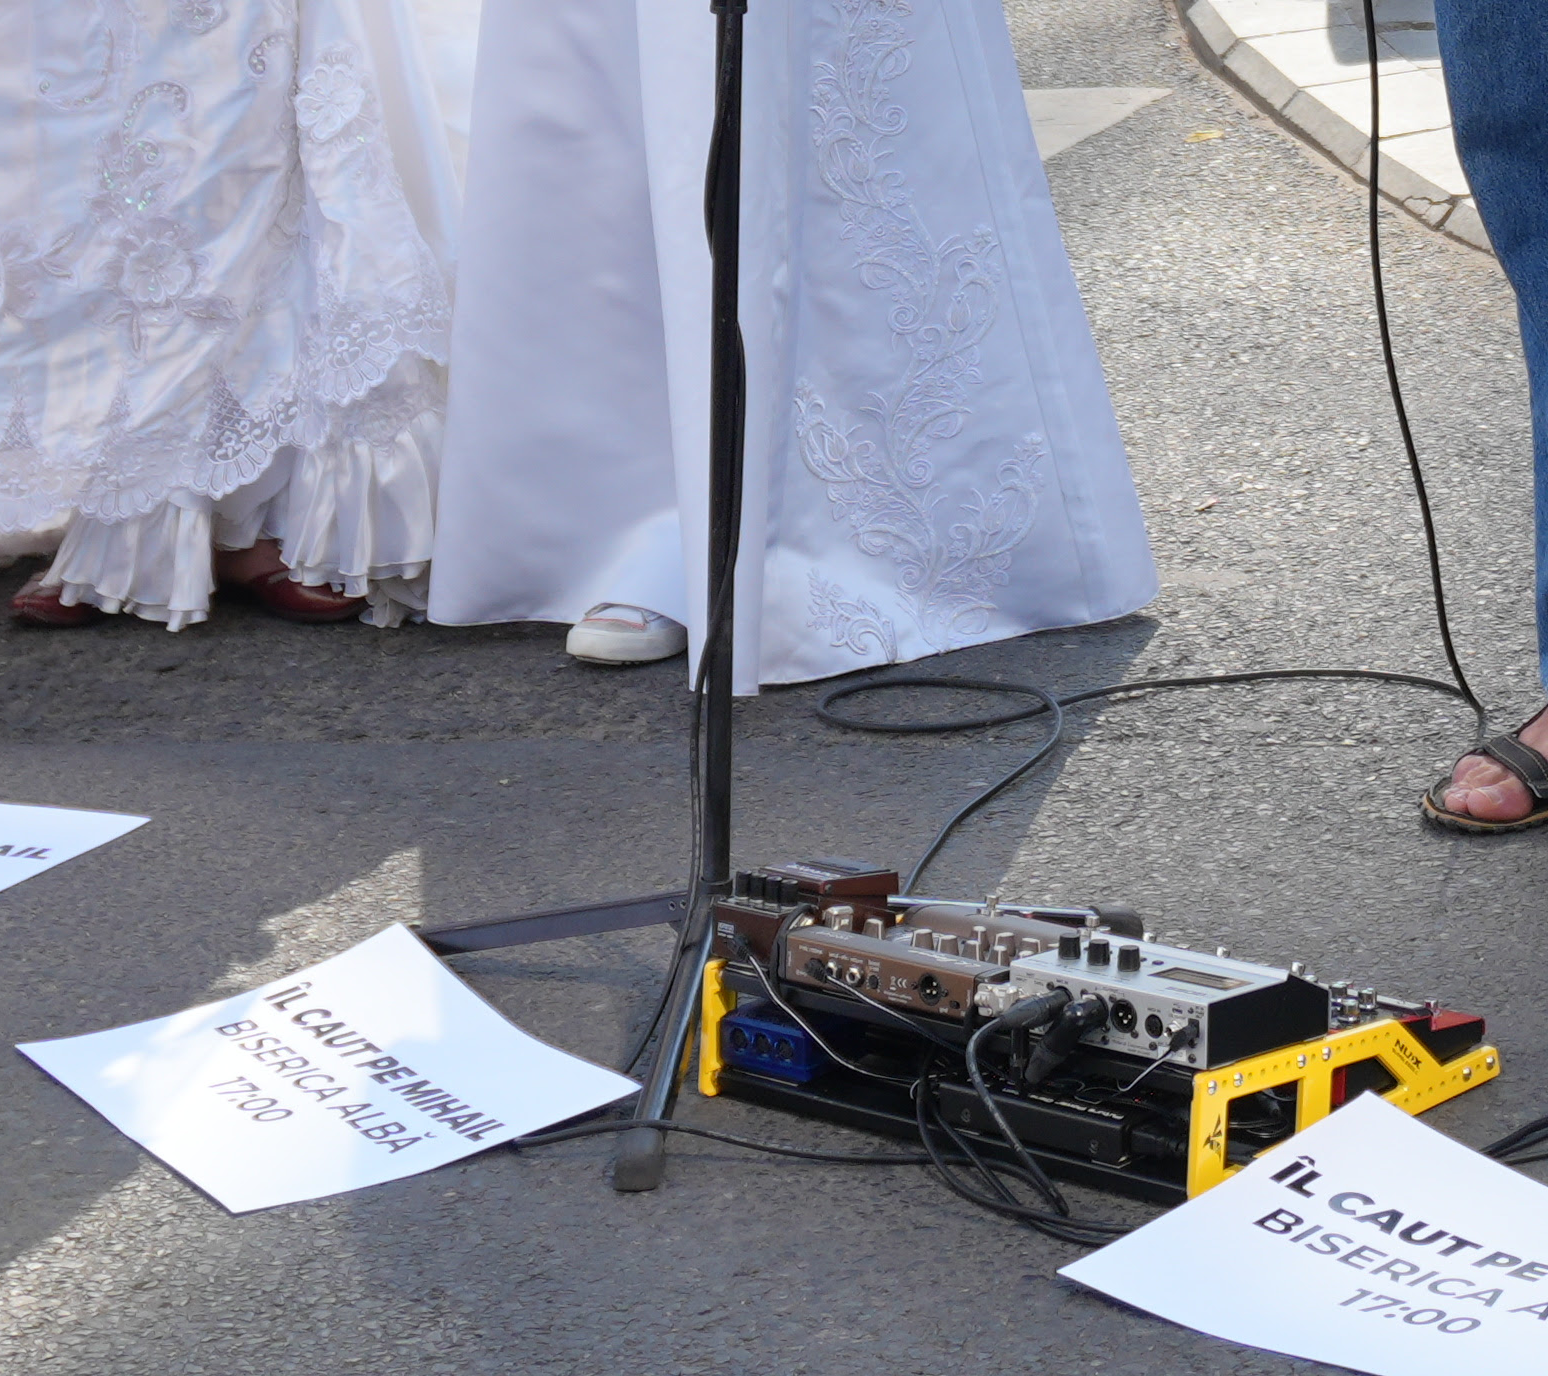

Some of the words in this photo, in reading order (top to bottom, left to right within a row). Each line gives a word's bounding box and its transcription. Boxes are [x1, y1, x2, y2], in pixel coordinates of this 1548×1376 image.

[208, 1075, 295, 1123] 17:00
[213, 1019, 349, 1103] BISERICA
[325, 1102, 438, 1155] ALBĂ
[263, 981, 313, 1012] ÎL
[290, 1008, 384, 1058] CAUT
[353, 1055, 419, 1085] PE
[389, 1079, 507, 1143] MIHAIL
[1252, 1207, 1509, 1308] BISERICA
[1268, 1155, 1324, 1199] ÎL
[1327, 1191, 1485, 1258] CAUT
[1338, 1287, 1483, 1336] 17:00
